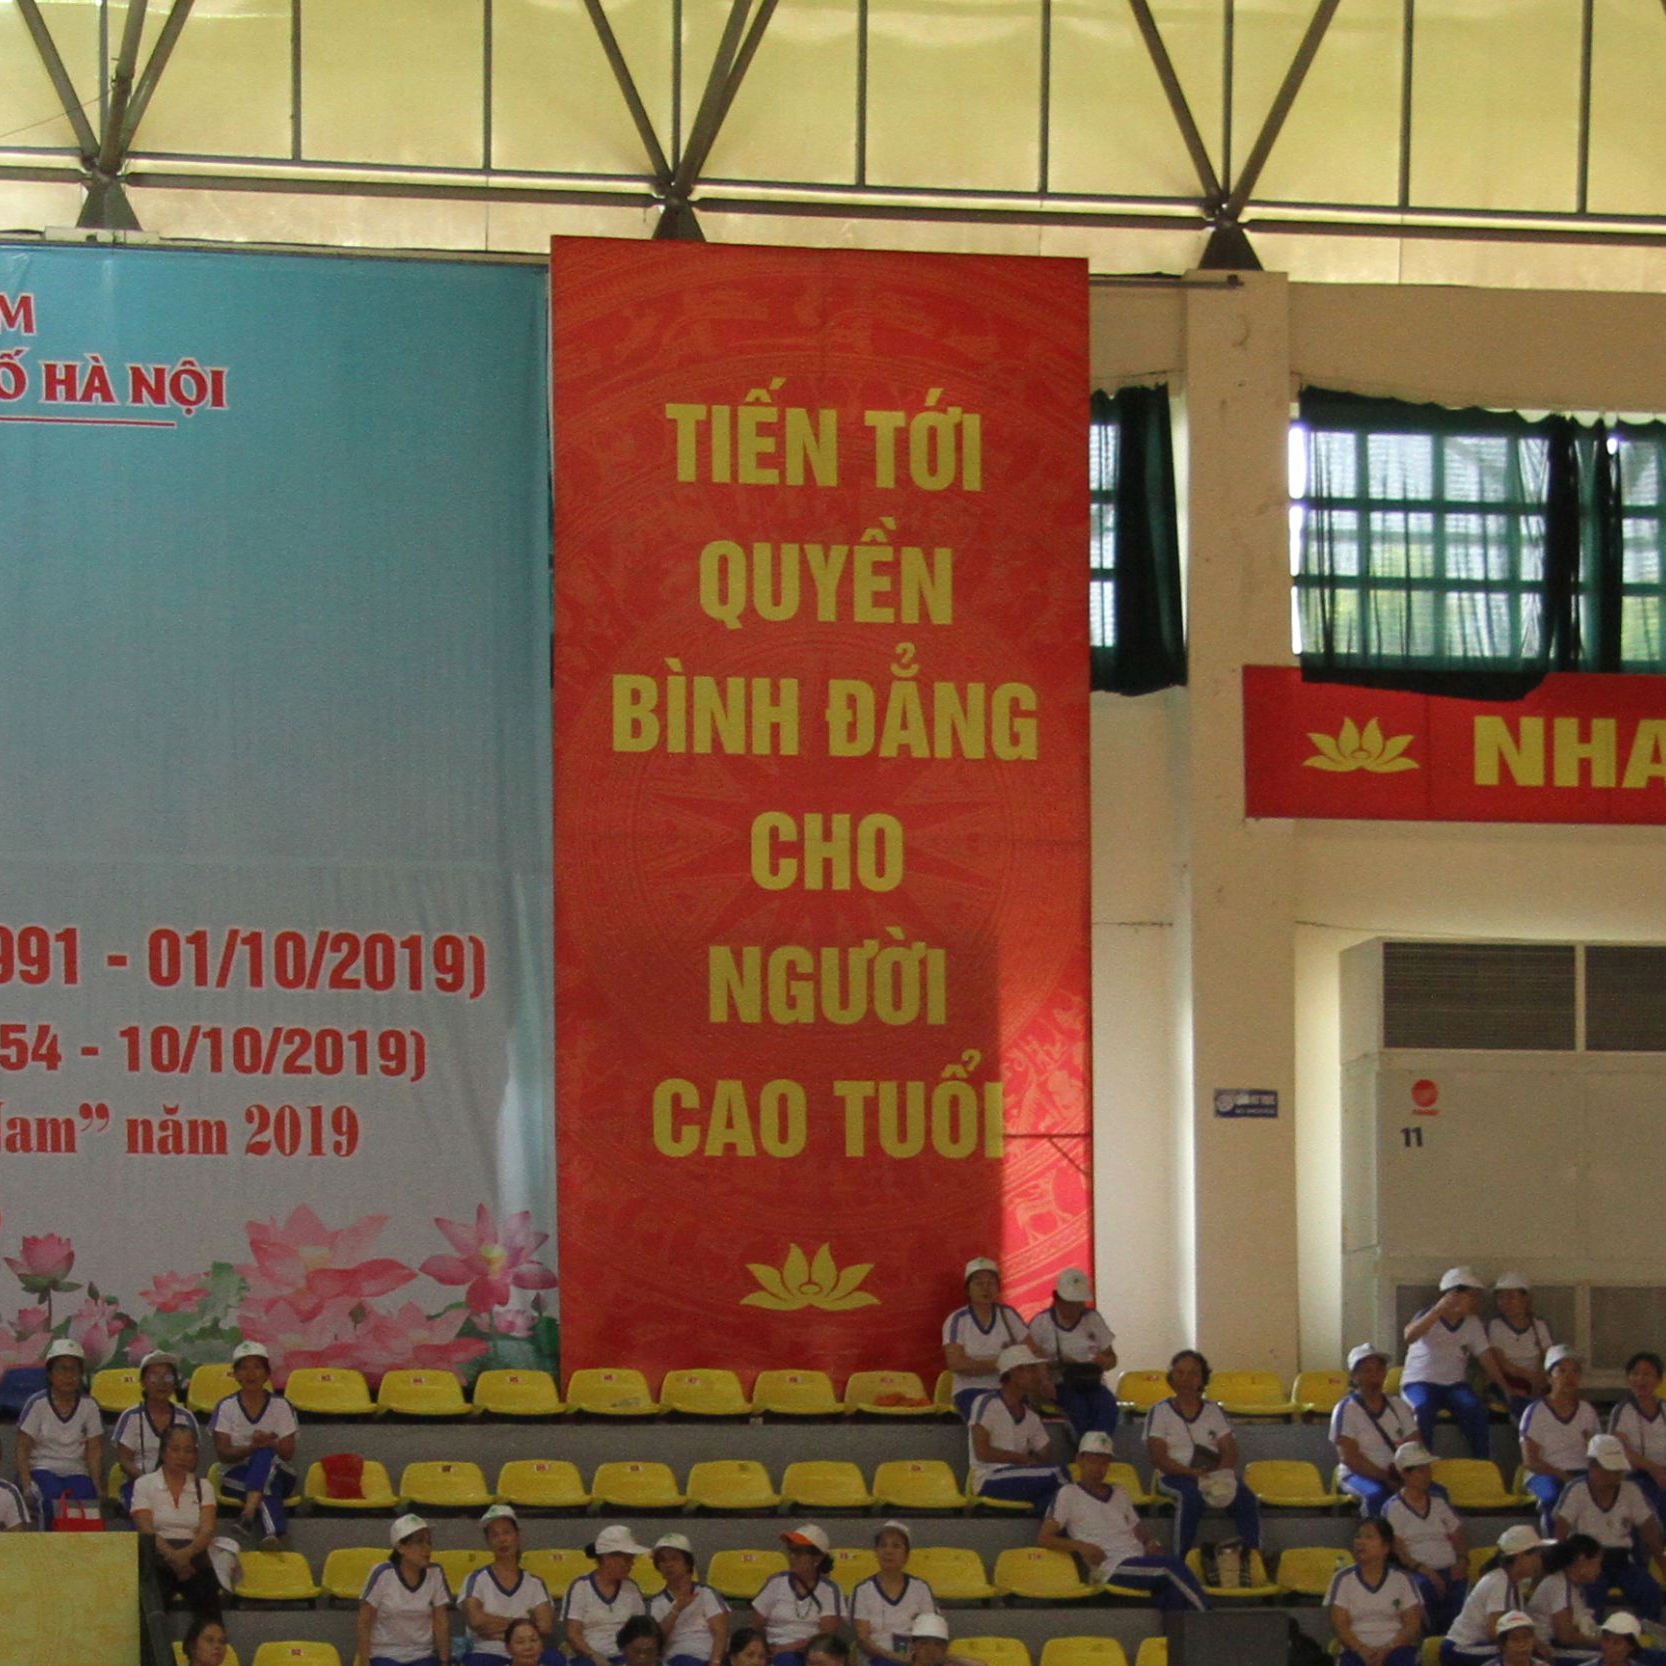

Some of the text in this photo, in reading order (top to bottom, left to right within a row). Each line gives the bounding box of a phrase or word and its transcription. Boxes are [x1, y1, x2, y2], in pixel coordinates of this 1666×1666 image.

[44, 356, 116, 403] HÀ
[130, 359, 226, 414] NỘI
[665, 377, 982, 491] TIẾN TỚI
[698, 516, 953, 630] QUYỀN
[612, 642, 1038, 761] BÌNH ĐẲNG
[751, 811, 905, 892] CHO
[147, 927, 487, 1000] 01/10/2019)
[708, 926, 947, 1025] NGƯỜI
[118, 1024, 427, 1084] 10/10/2019)
[125, 1104, 230, 1157] năm
[244, 1103, 362, 1159] 2019
[653, 1049, 1004, 1159] CAO TUỔI
[1400, 1127, 1423, 1147] 11
